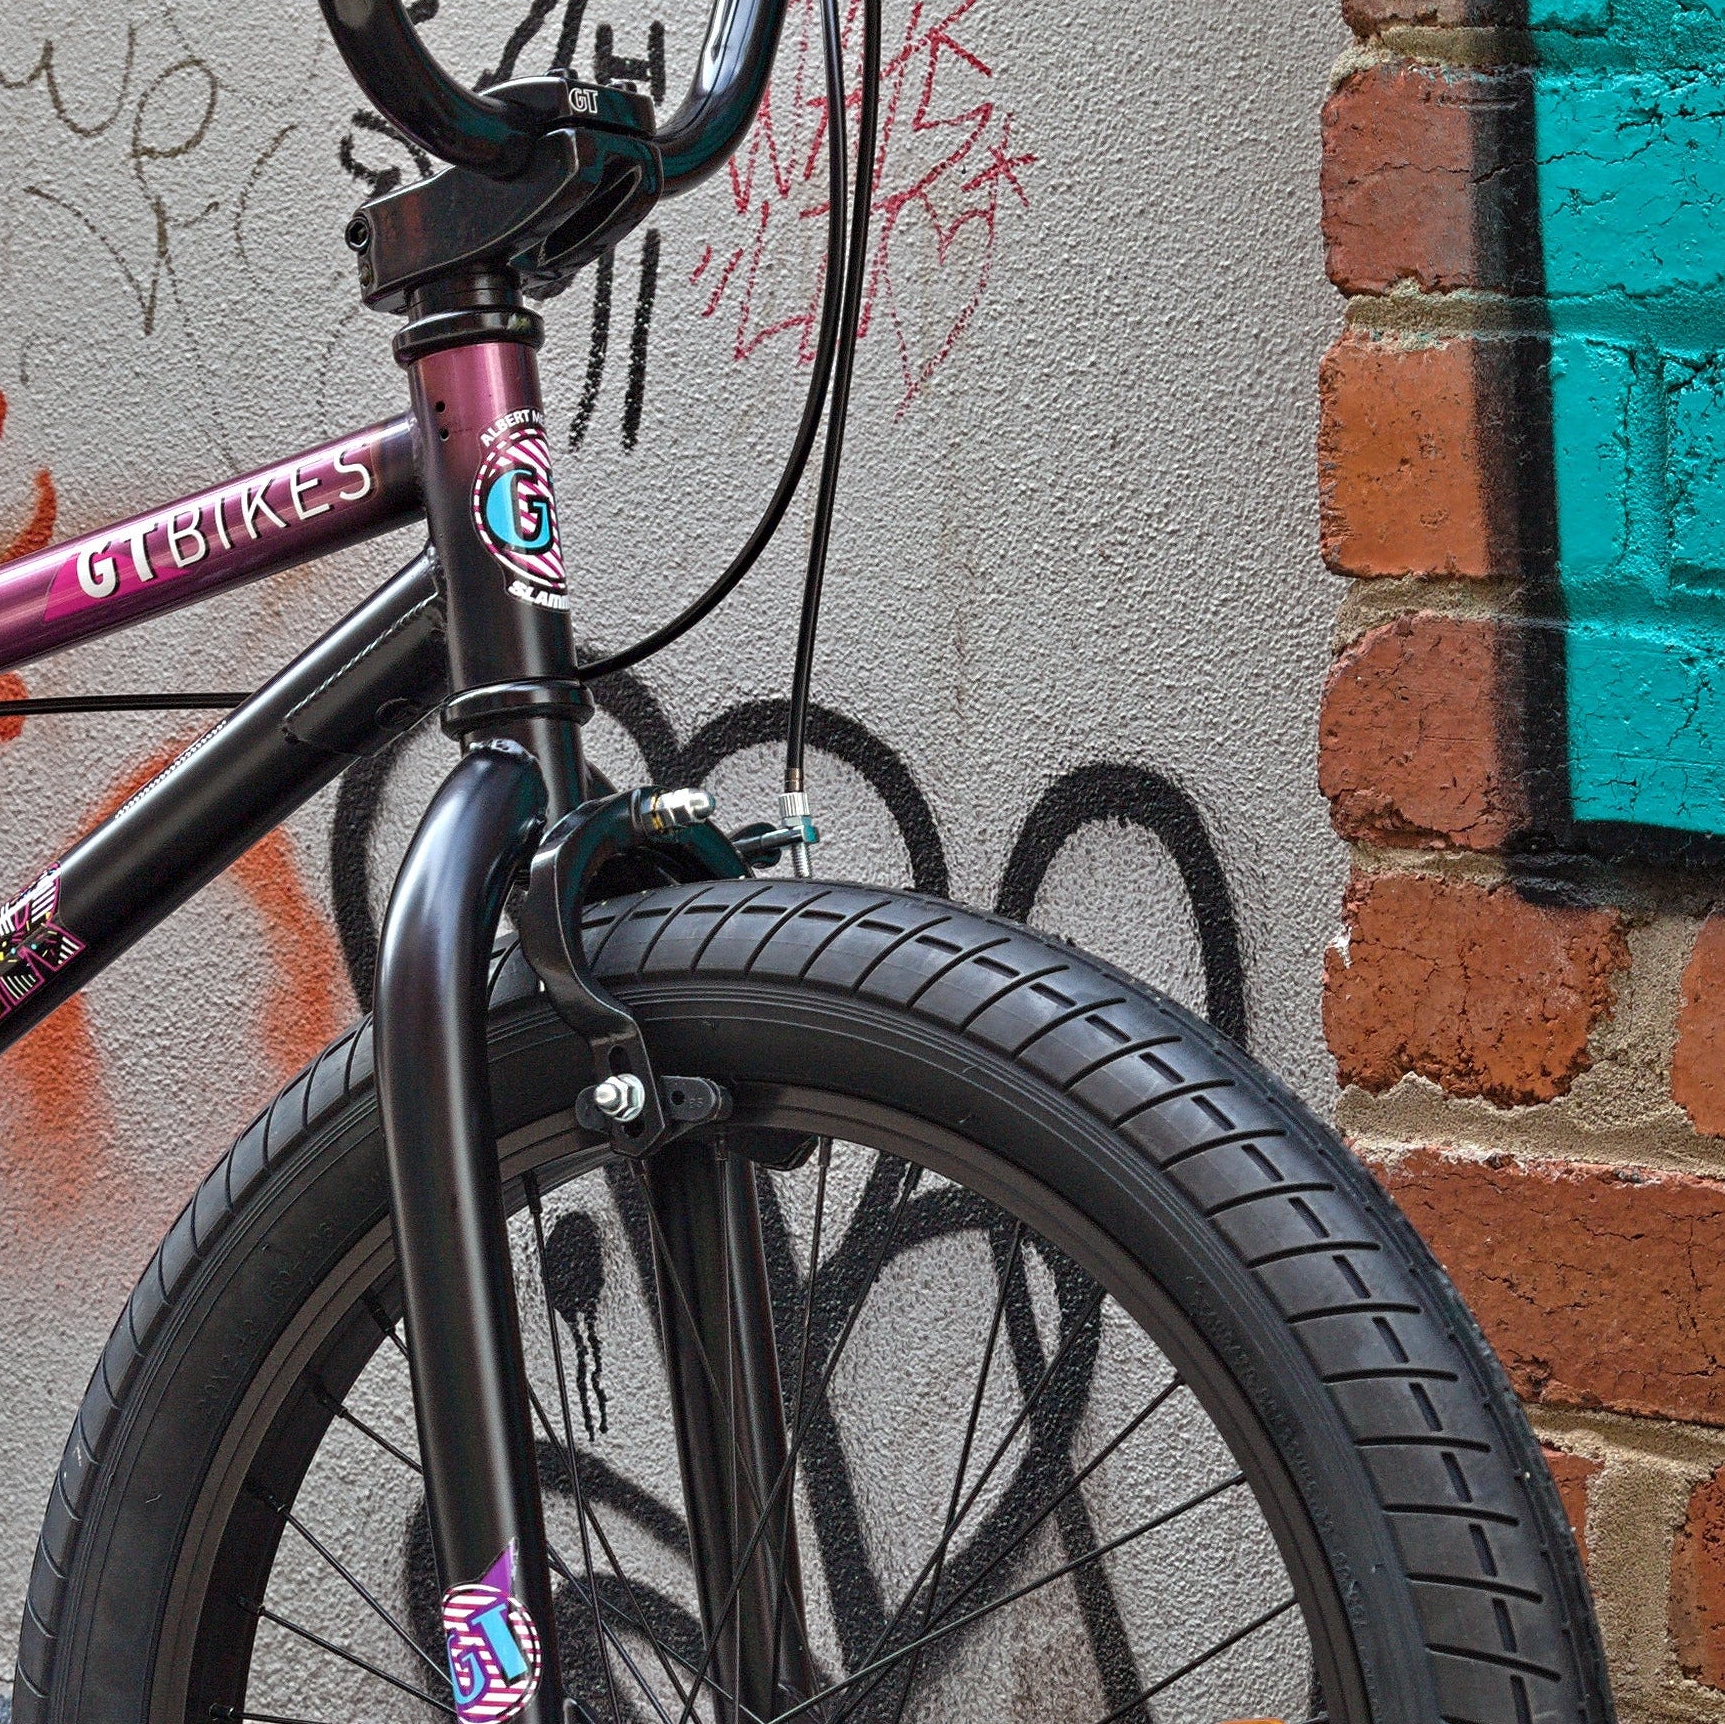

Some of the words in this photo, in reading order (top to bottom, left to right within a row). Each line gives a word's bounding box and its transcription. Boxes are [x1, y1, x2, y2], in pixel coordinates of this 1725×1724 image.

[568, 87, 599, 114] GT
[479, 408, 532, 448] ALBERT
[446, 1602, 529, 1706] GT
